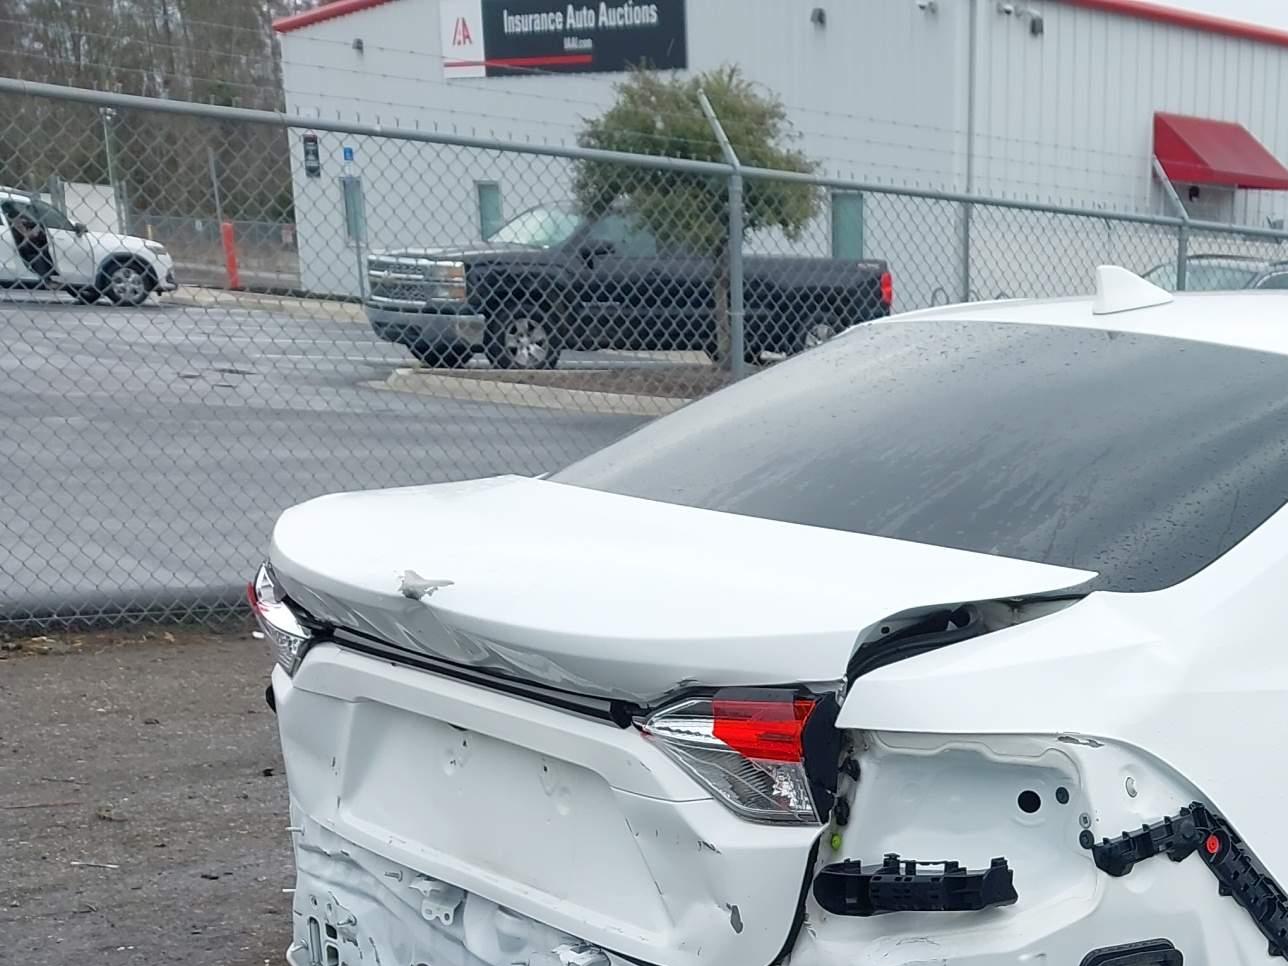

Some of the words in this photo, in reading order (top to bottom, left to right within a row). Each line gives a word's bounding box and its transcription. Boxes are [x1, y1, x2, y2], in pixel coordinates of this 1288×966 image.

[503, 9, 563, 33] Insurance
[566, 4, 595, 29] Auto
[598, 0, 658, 27] Auctions
